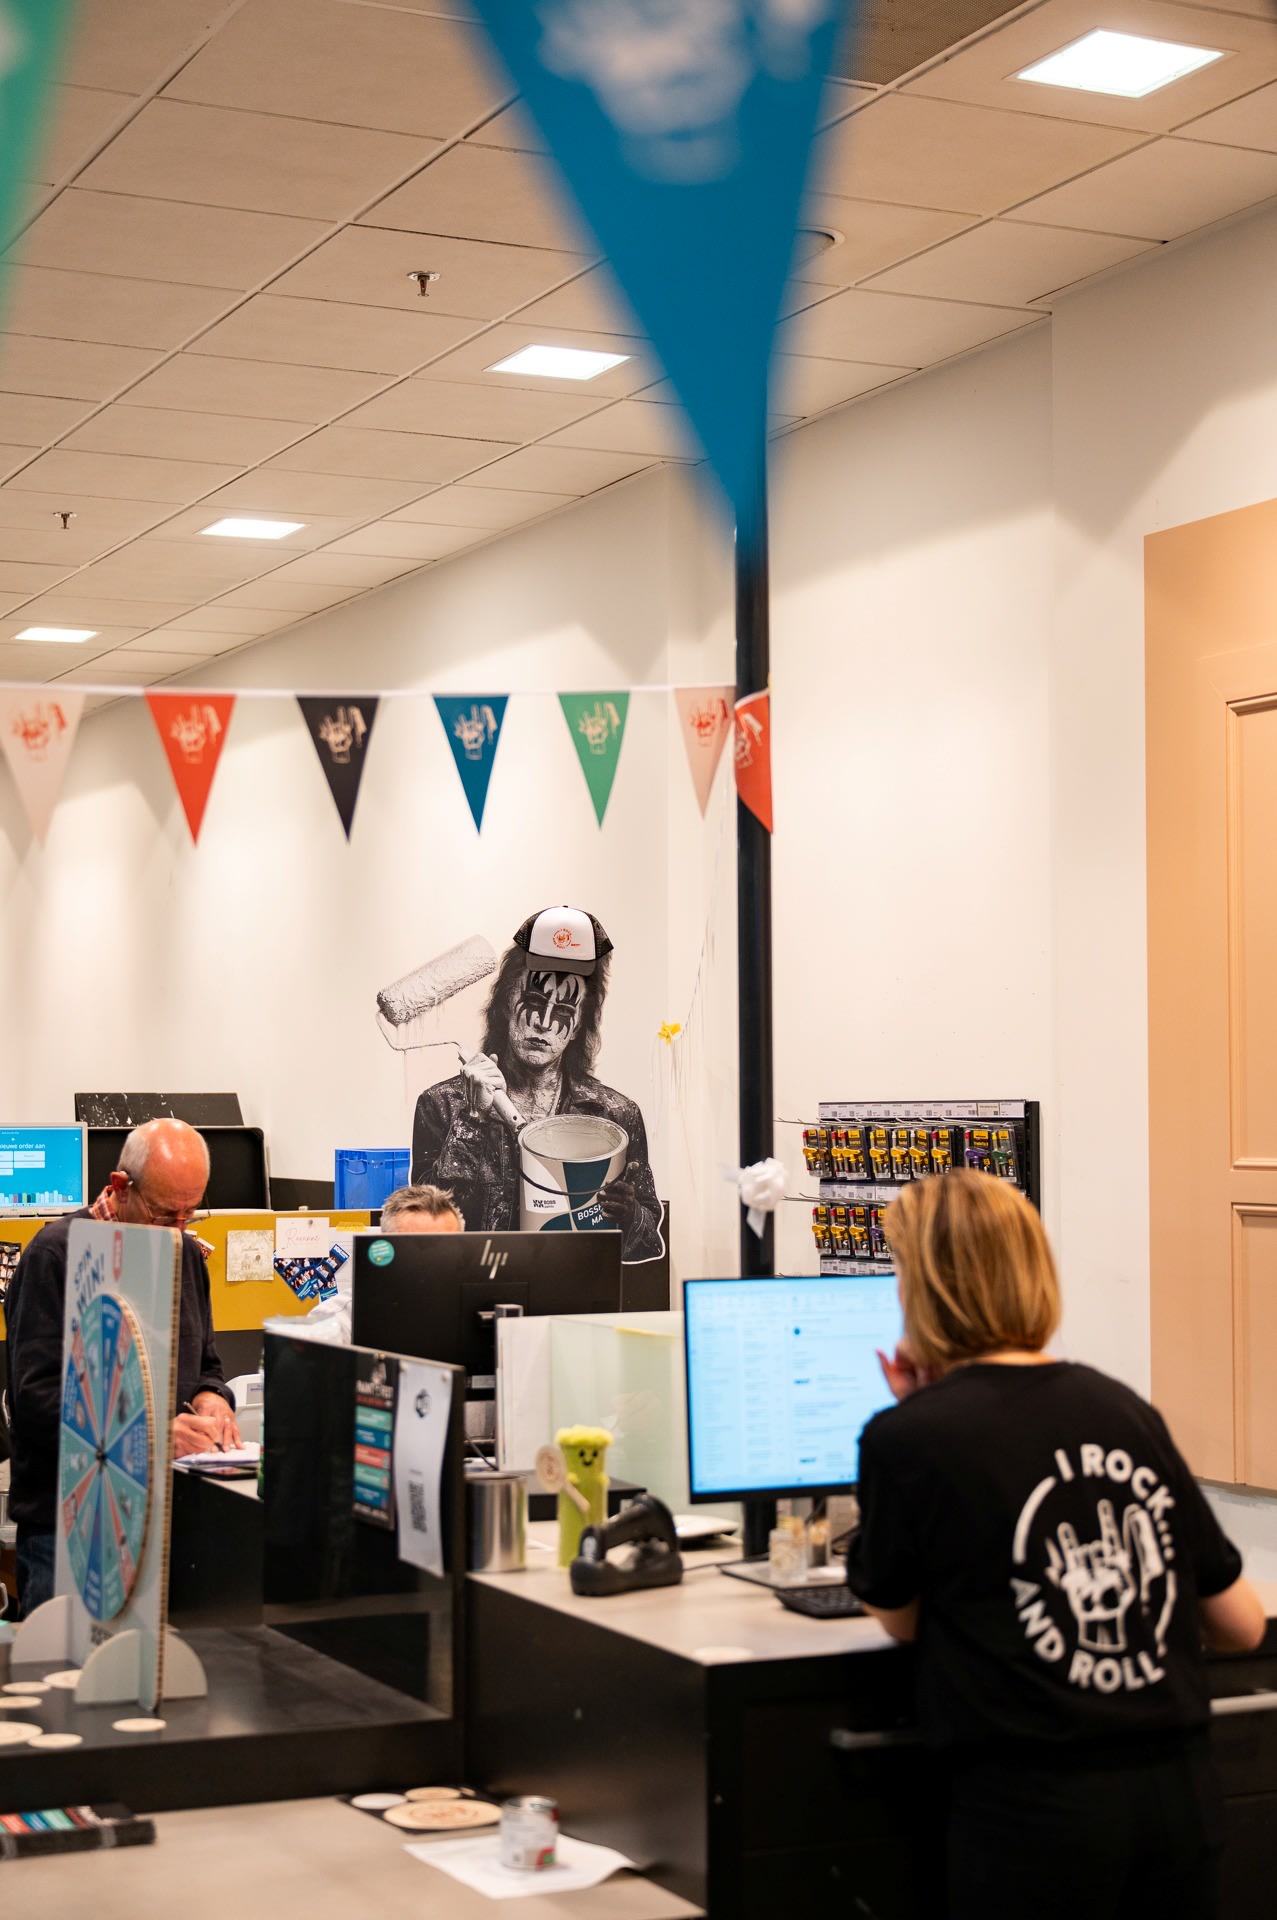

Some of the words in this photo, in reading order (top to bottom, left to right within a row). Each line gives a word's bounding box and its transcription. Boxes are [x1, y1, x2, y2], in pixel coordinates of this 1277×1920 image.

[480, 1239, 509, 1279] hp
[1054, 1448, 1075, 1483] I
[1009, 1576, 1066, 1662] AND
